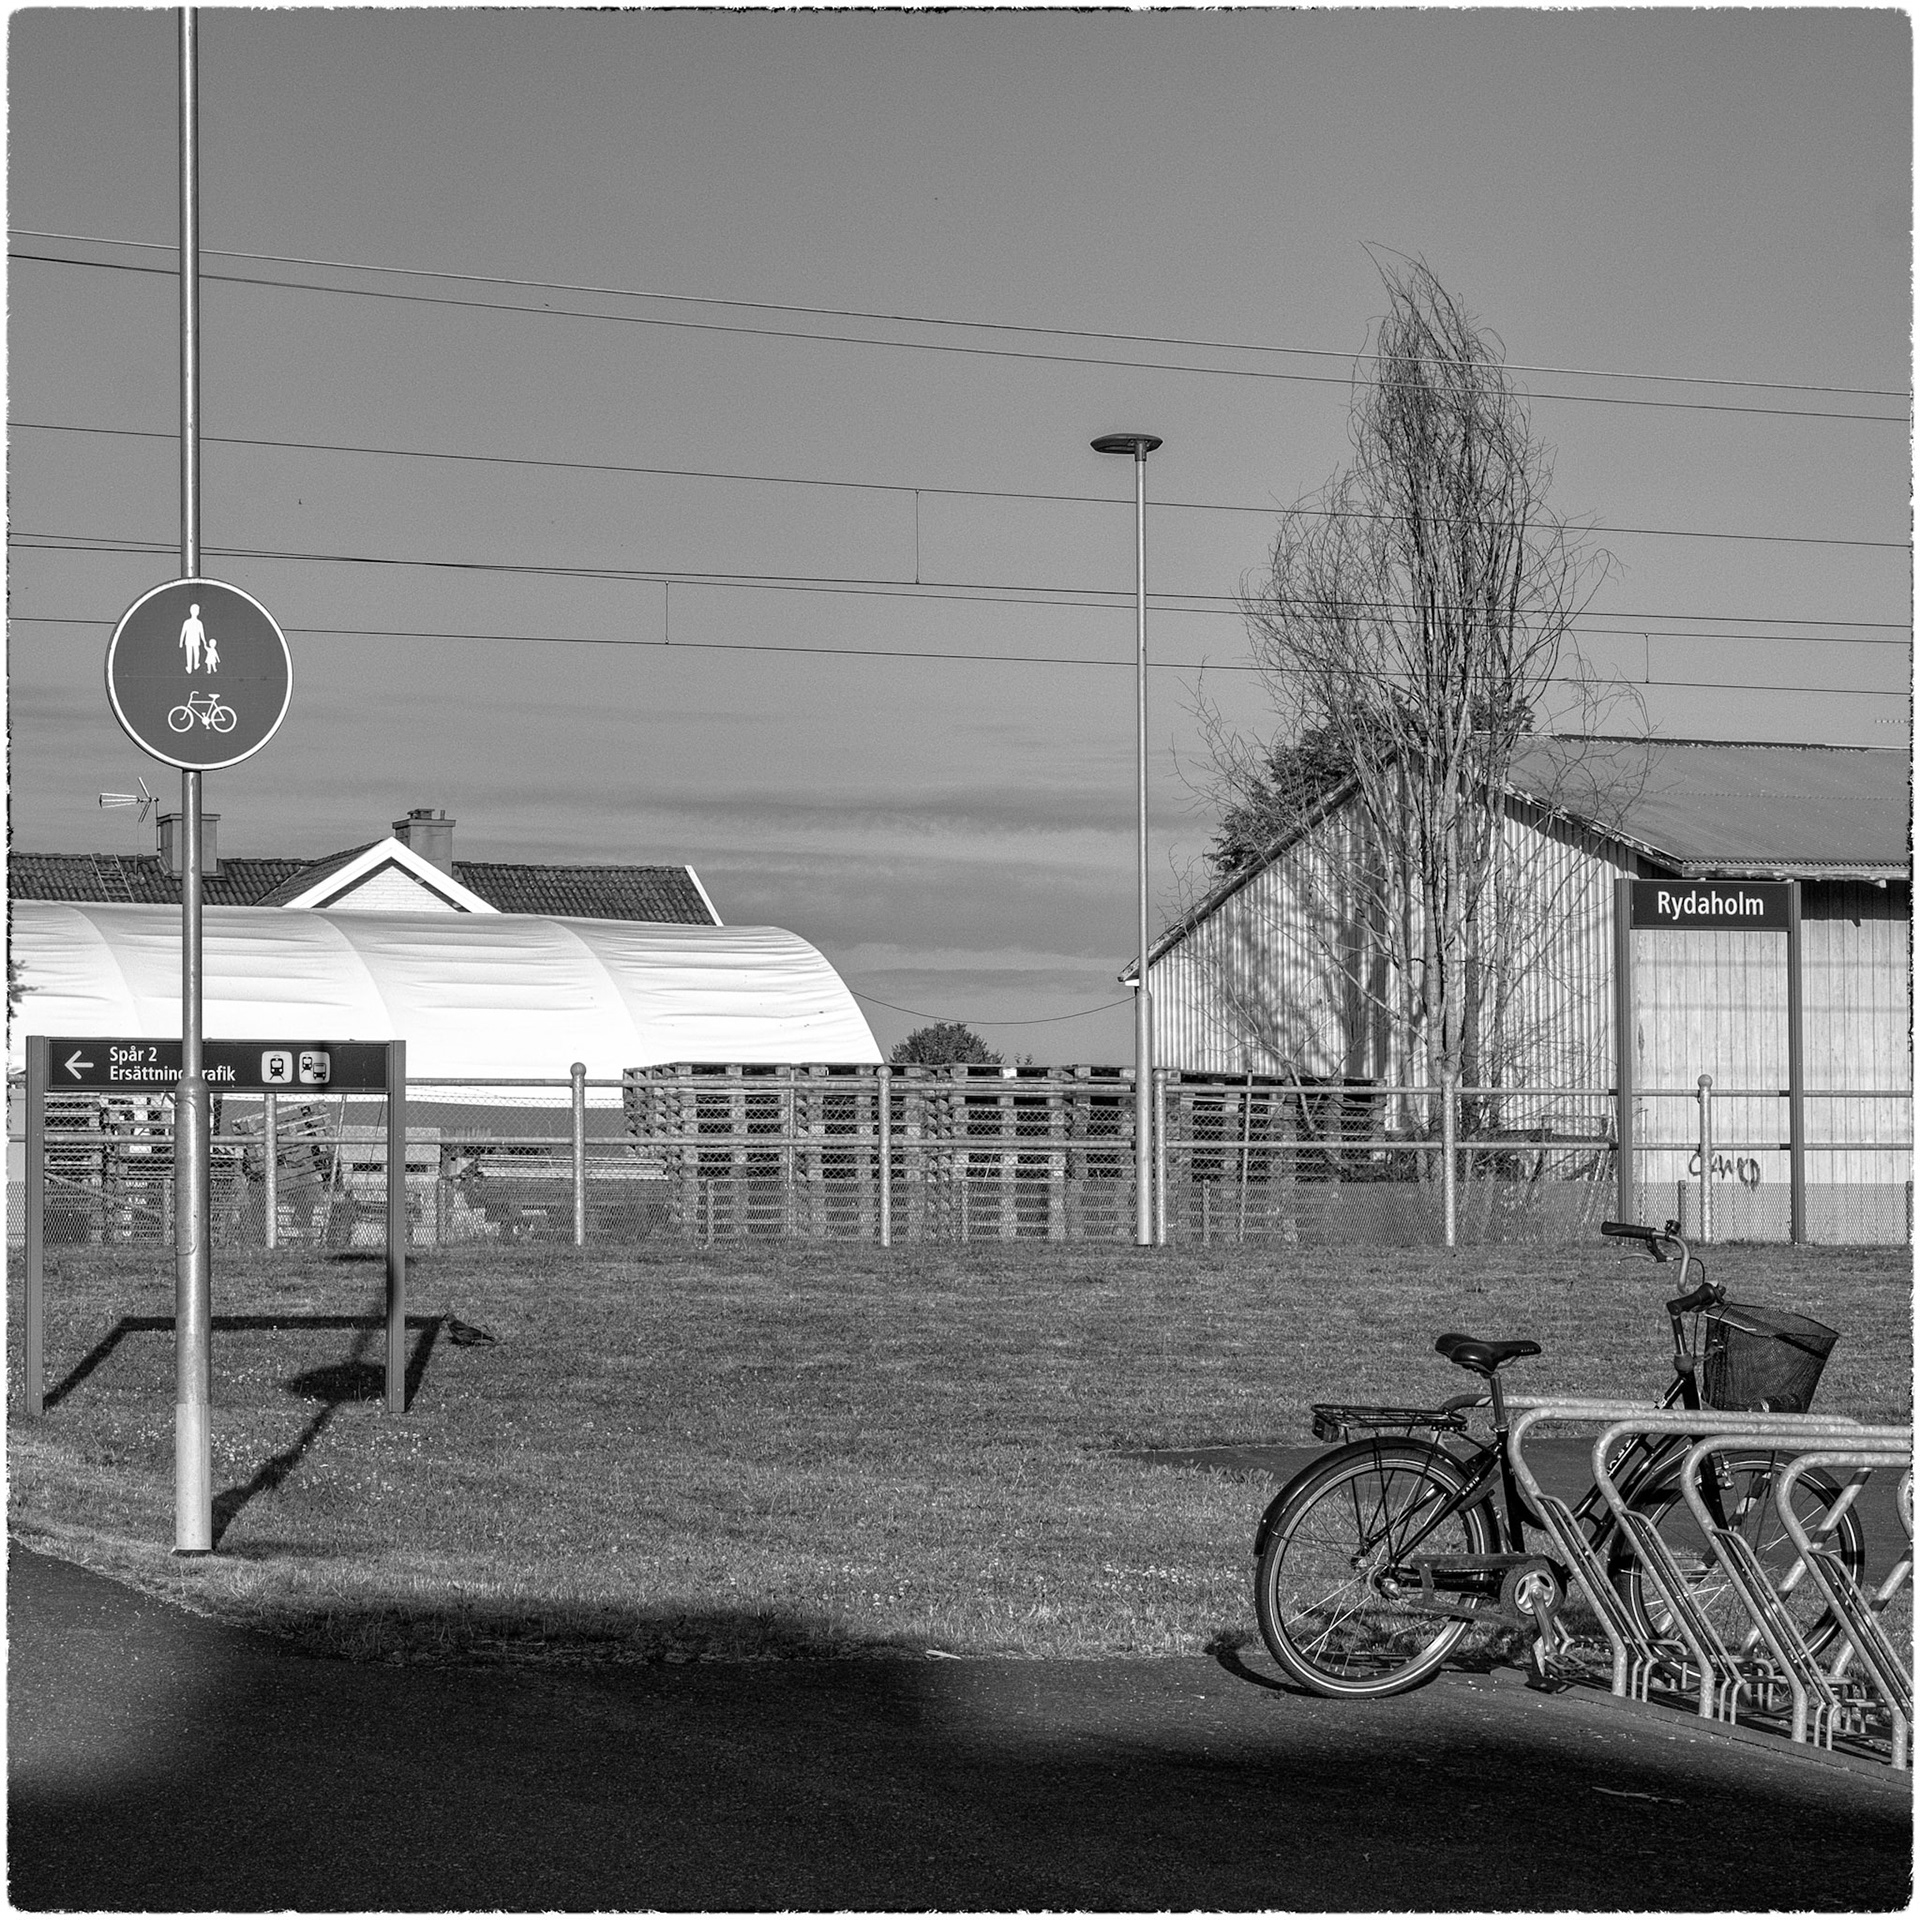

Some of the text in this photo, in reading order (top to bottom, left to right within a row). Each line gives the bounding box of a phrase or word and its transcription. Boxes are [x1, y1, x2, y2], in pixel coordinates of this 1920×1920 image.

[1657, 890, 1764, 920] Rydaholm
[109, 1045, 157, 1066] Spår 2
[109, 1065, 236, 1081] Ersättninrafik
